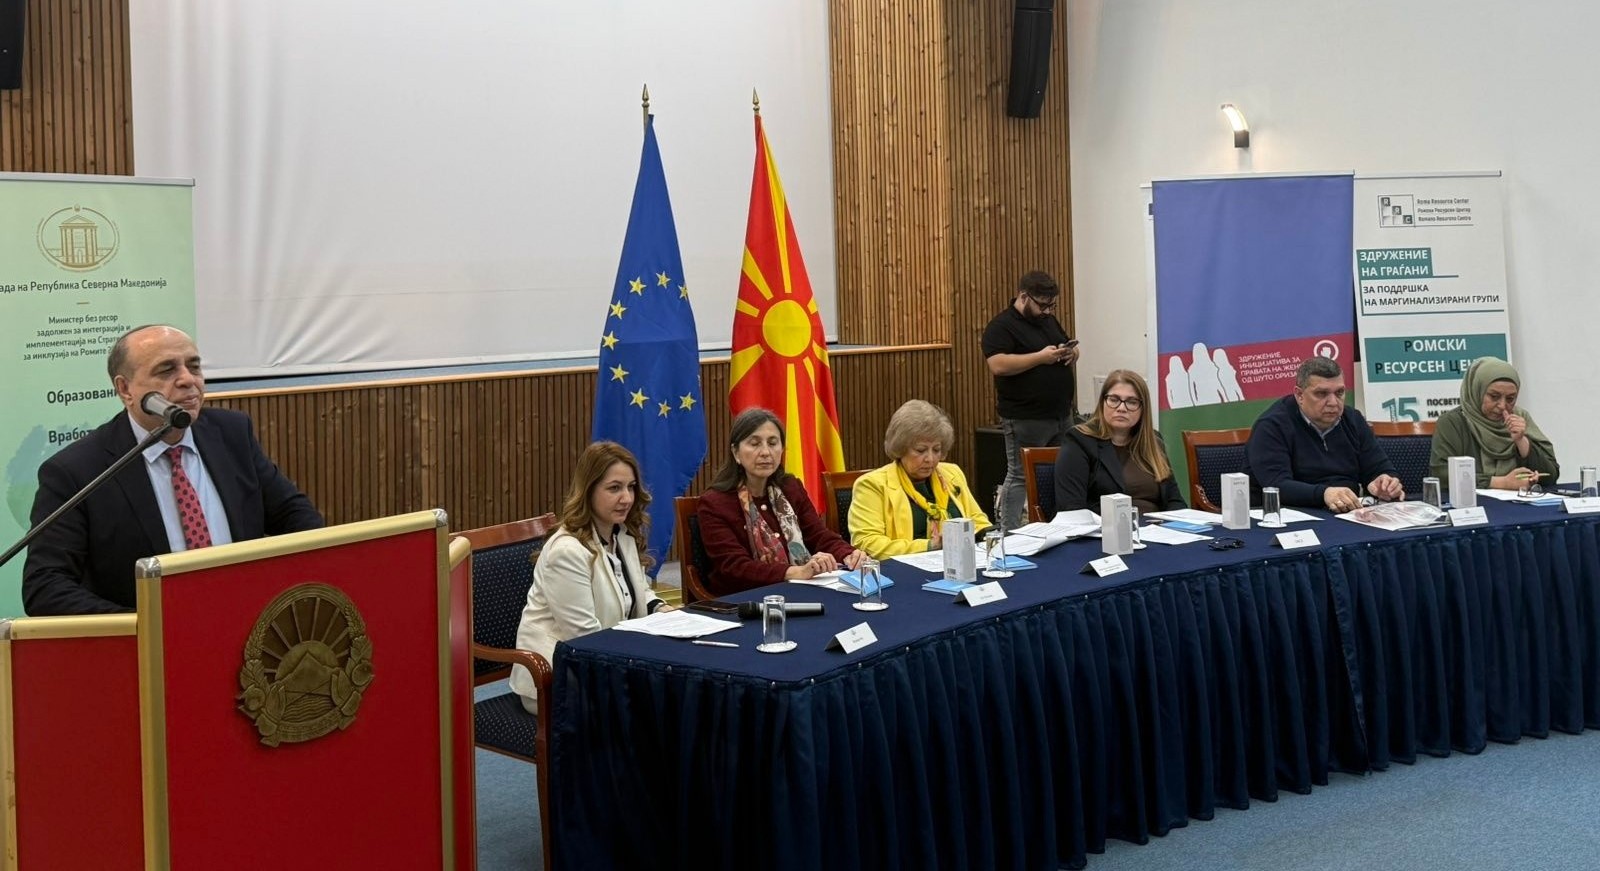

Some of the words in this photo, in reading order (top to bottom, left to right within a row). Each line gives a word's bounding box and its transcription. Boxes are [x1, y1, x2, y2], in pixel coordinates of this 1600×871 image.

[1359, 250, 1429, 263] ЗДРУЖЕНИЕ
[1361, 267, 1378, 277] НА
[1380, 263, 1429, 276] ГРАЃАНИ
[0, 284, 16, 293] ада
[18, 284, 28, 292] на
[30, 281, 79, 293] Република
[81, 280, 118, 291] Северна
[120, 278, 167, 289] Македонија
[1363, 286, 1376, 294] ЗА
[1377, 285, 1429, 295] ПОДДРШКА
[1364, 298, 1377, 306] НА
[1379, 296, 1471, 306] МАРГИНАЛИЗИРАНИ
[1472, 295, 1500, 304] ГРУПИ
[48, 316, 83, 324] Министер
[85, 314, 98, 322] без
[99, 314, 119, 323] ресор
[36, 328, 72, 337] задолжен
[83, 324, 125, 334] интеграција
[26, 338, 86, 348] имплементација
[1404, 338, 1467, 352] РОМСКИ
[33, 350, 69, 361] инклузија
[80, 348, 106, 356] Ромите
[1238, 351, 1281, 362] ЗДРУЖЕНИЕ
[1240, 357, 1291, 369] ИНИЦИЈАТИВА
[1375, 360, 1445, 374] РЕСУРСЕН
[1240, 367, 1271, 376] ПРАВАТА
[1253, 374, 1273, 382] ШУТО
[1381, 397, 1420, 423] 15
[1428, 410, 1439, 418] НА
